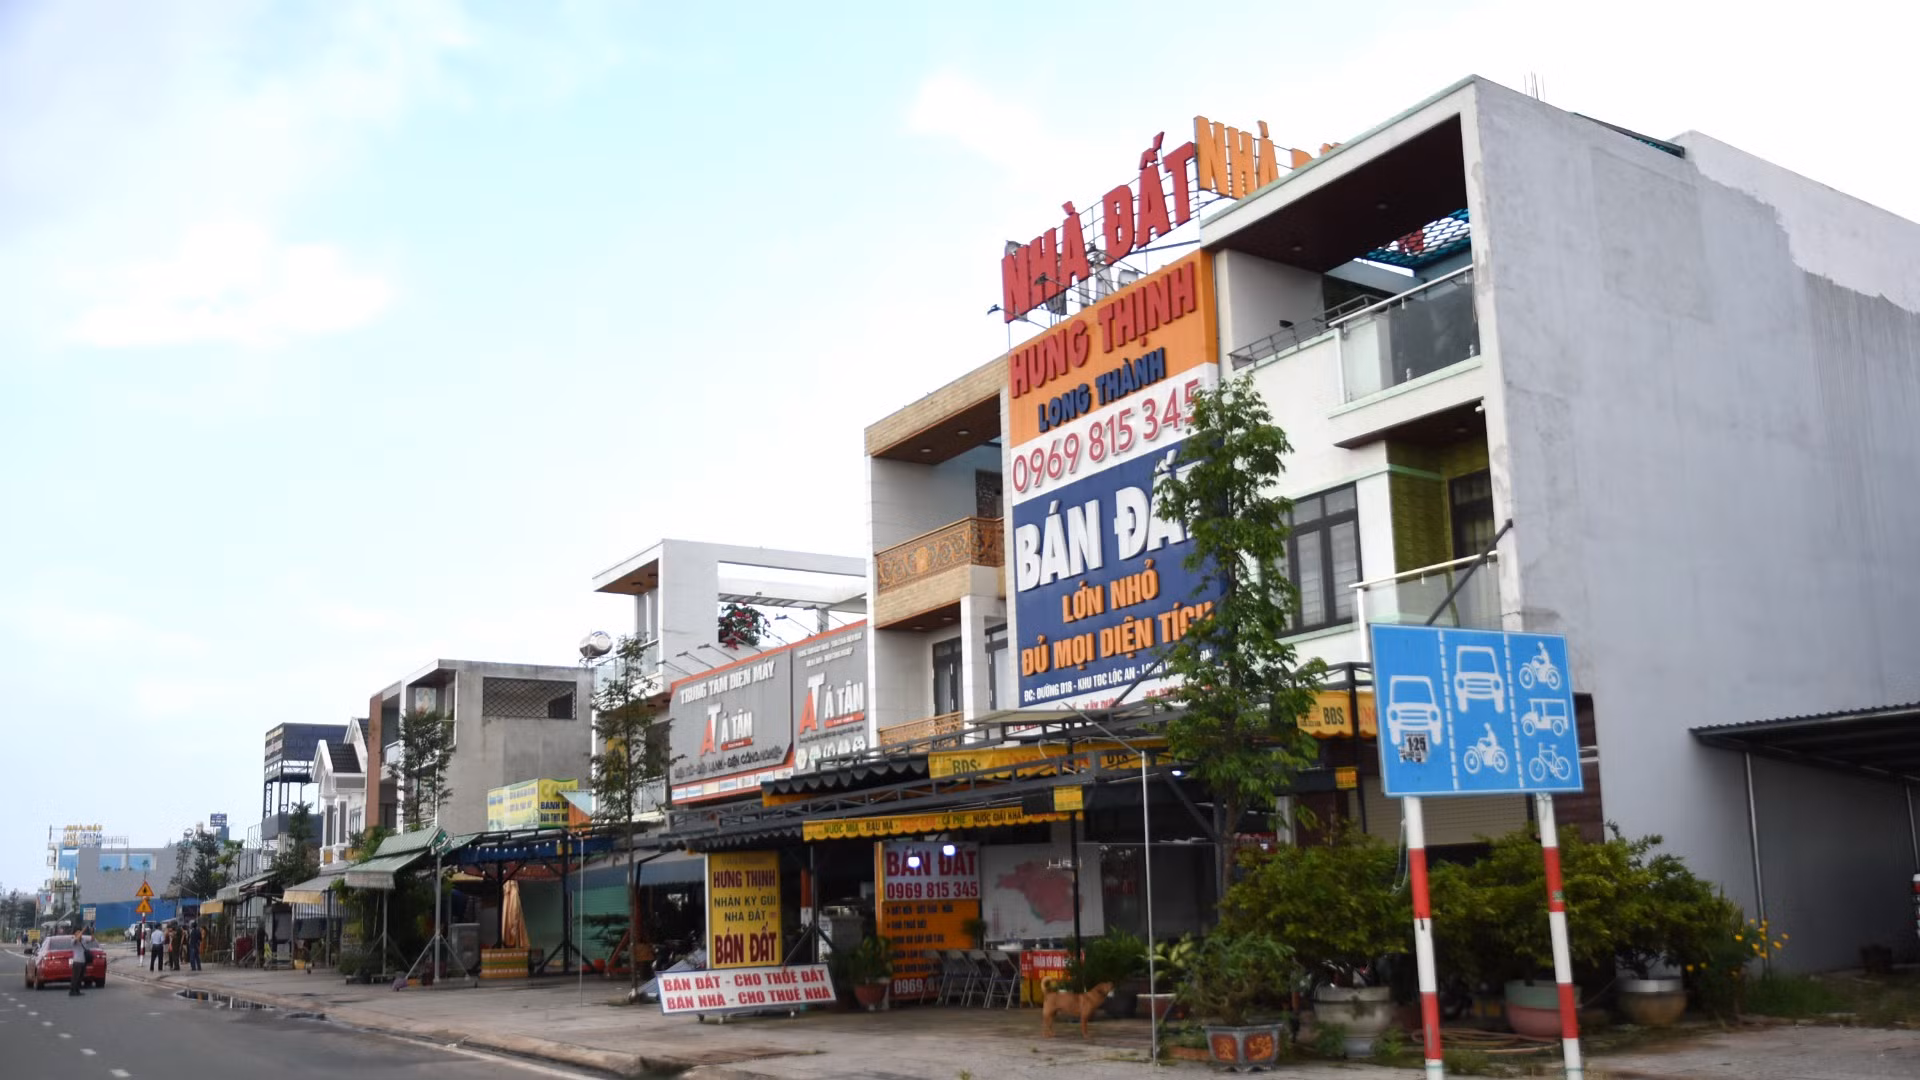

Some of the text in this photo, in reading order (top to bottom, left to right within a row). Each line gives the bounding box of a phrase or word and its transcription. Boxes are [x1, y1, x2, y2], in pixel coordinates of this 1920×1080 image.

[1194, 115, 1279, 199] NHÀ
[1002, 131, 1196, 323] NHÀ ĐẤT
[1098, 261, 1196, 347] THỊNH
[1038, 347, 1166, 433] LONG THÀNH
[1012, 432, 1080, 493] 0969
[1088, 408, 1133, 461] 815
[1016, 500, 1102, 592] BÁN
[1062, 559, 1159, 624] LỚN NHỎ
[1022, 636, 1050, 676] ĐỦ
[1054, 633, 1096, 670] MỌI
[1101, 616, 1155, 660] DIỆN
[680, 682, 707, 705] TRUNG
[1060, 681, 1072, 694] D18
[1077, 676, 1092, 690] KHU
[1124, 666, 1136, 680] AN
[745, 869, 776, 891] THỊNH
[887, 881, 978, 899] 0969 815 345
[715, 921, 777, 964] BÁN ĐẤT
[664, 975, 691, 992] BÁN
[734, 973, 762, 987] CHO
[667, 993, 695, 1010] BÁN
[738, 991, 765, 1005] CHO
